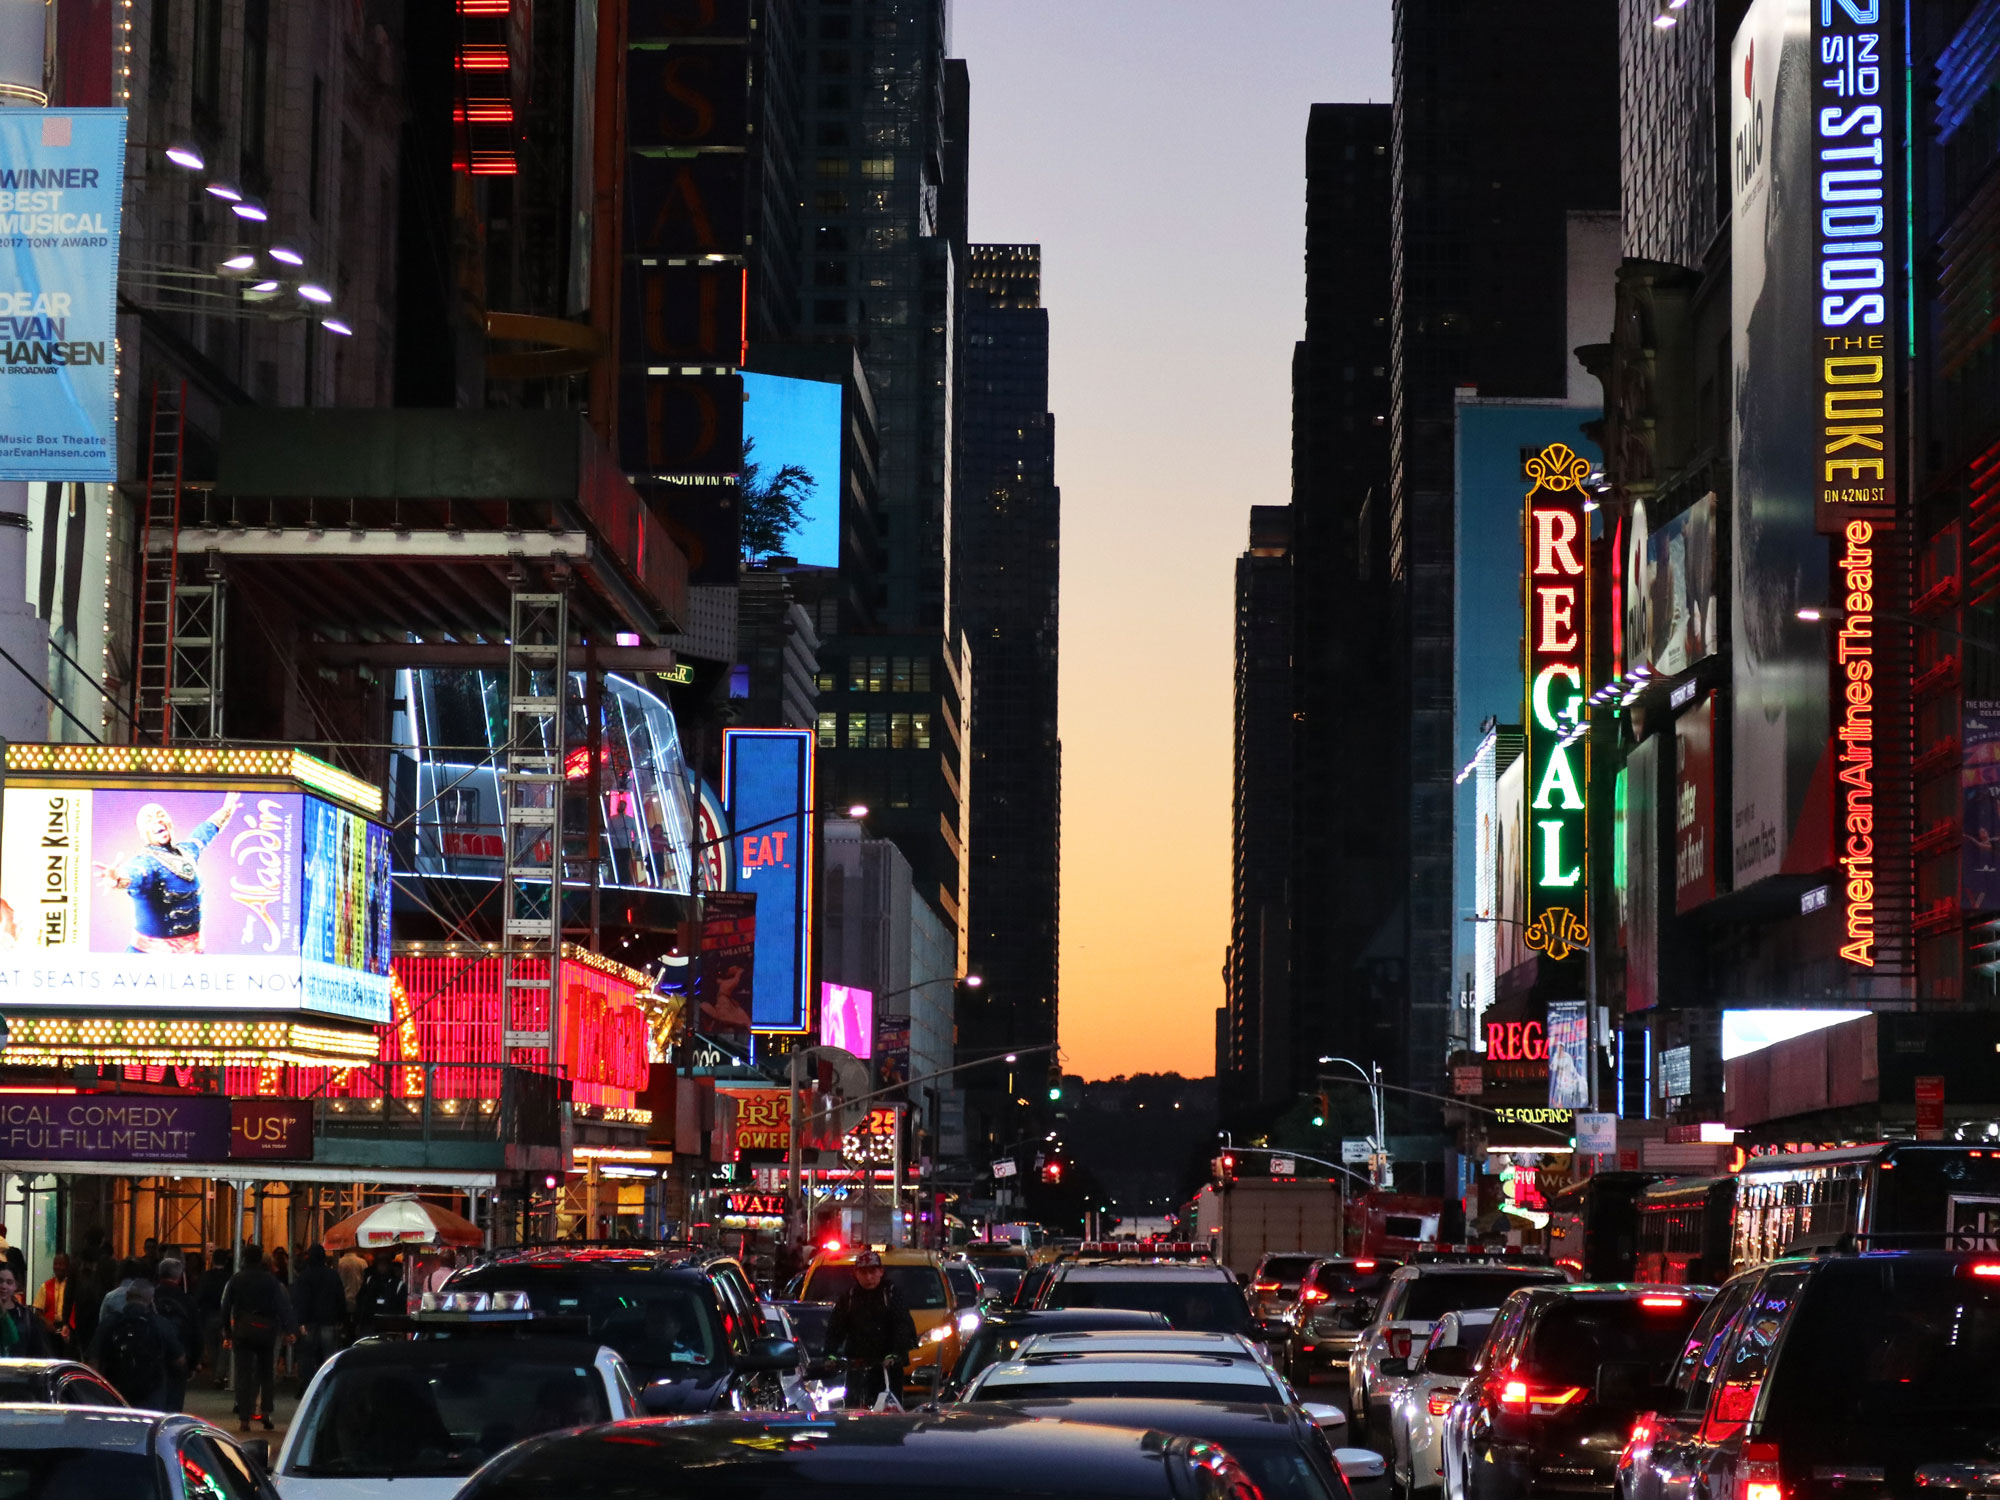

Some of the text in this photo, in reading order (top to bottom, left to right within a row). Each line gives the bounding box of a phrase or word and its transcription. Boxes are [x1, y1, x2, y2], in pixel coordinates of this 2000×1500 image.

[1736, 98, 1764, 193] nulo
[0, 168, 99, 189] WINNER
[0, 190, 63, 212] BEST
[0, 213, 108, 235] MUSICAL
[1819, 104, 1884, 326] STUDIOS
[28, 238, 60, 248] TONY
[61, 237, 108, 248] AWARD
[0, 317, 65, 341] EVAN
[1823, 335, 1885, 350] THE
[0, 341, 105, 366] HANSEN
[8, 366, 59, 375] BROADWAY
[1823, 355, 1885, 483] DUKE
[1, 434, 106, 445] Music Box Theatre
[1824, 487, 1885, 503] ON 42ND ST
[1533, 510, 1584, 888] REGAL
[40, 797, 69, 947] THE LION KING
[230, 799, 283, 953] Aladdin
[282, 813, 293, 939] THE HIT BROADWAY MUSICAL
[33, 970, 101, 989] SEATS
[113, 972, 236, 991] AVAILABLE
[68, 1106, 178, 1127] COMEDY
[1495, 1108, 1573, 1124] THE GOLDFINCH
[1583, 1116, 1609, 1125] NYPD
[1581, 1141, 1611, 1149] CAMERA
